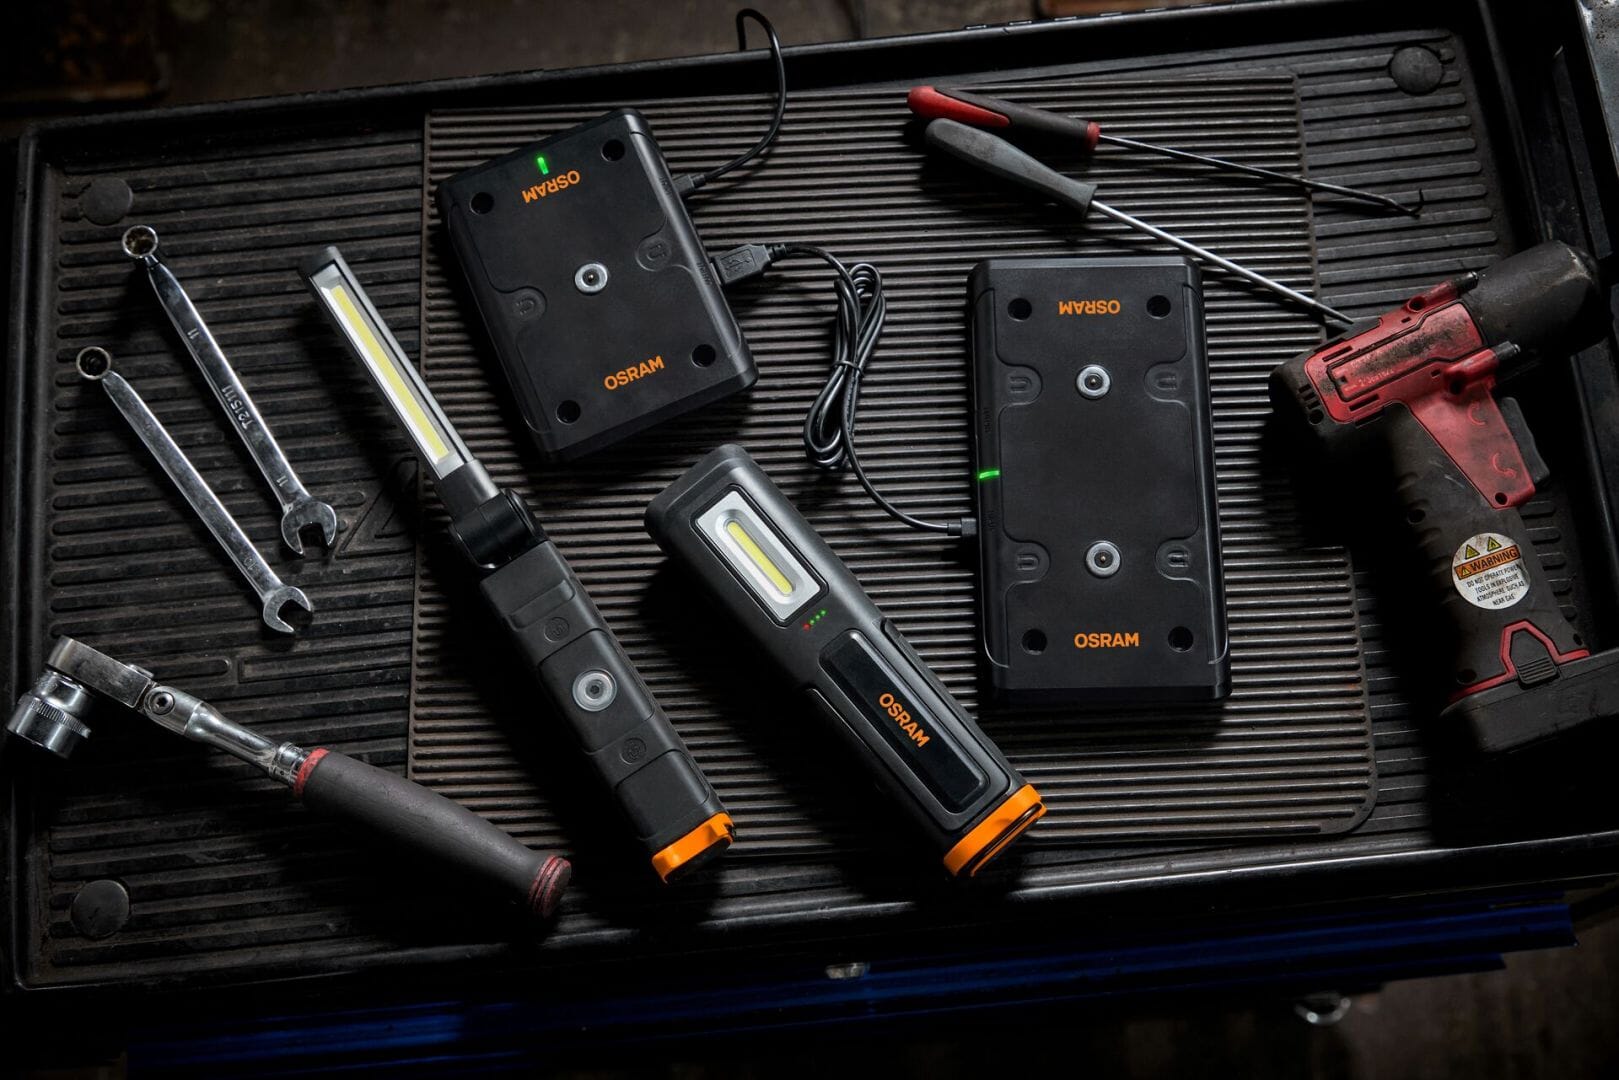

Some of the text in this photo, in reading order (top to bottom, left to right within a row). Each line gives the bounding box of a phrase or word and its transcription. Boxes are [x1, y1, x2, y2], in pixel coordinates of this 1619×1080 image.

[520, 169, 582, 204] OSRAM
[1058, 299, 1121, 316] OSRAM
[187, 328, 200, 340] 11
[602, 355, 665, 392] OSRAM
[221, 384, 254, 430] T215111
[276, 475, 289, 487] 11
[1470, 549, 1518, 572] WARNING
[1466, 580, 1475, 588] DO
[1474, 576, 1484, 584] NOT
[1484, 569, 1505, 581] OPERATE
[1475, 583, 1490, 593] TOOLS
[1073, 632, 1140, 649] OSRAM
[878, 692, 931, 748] OSRAM
